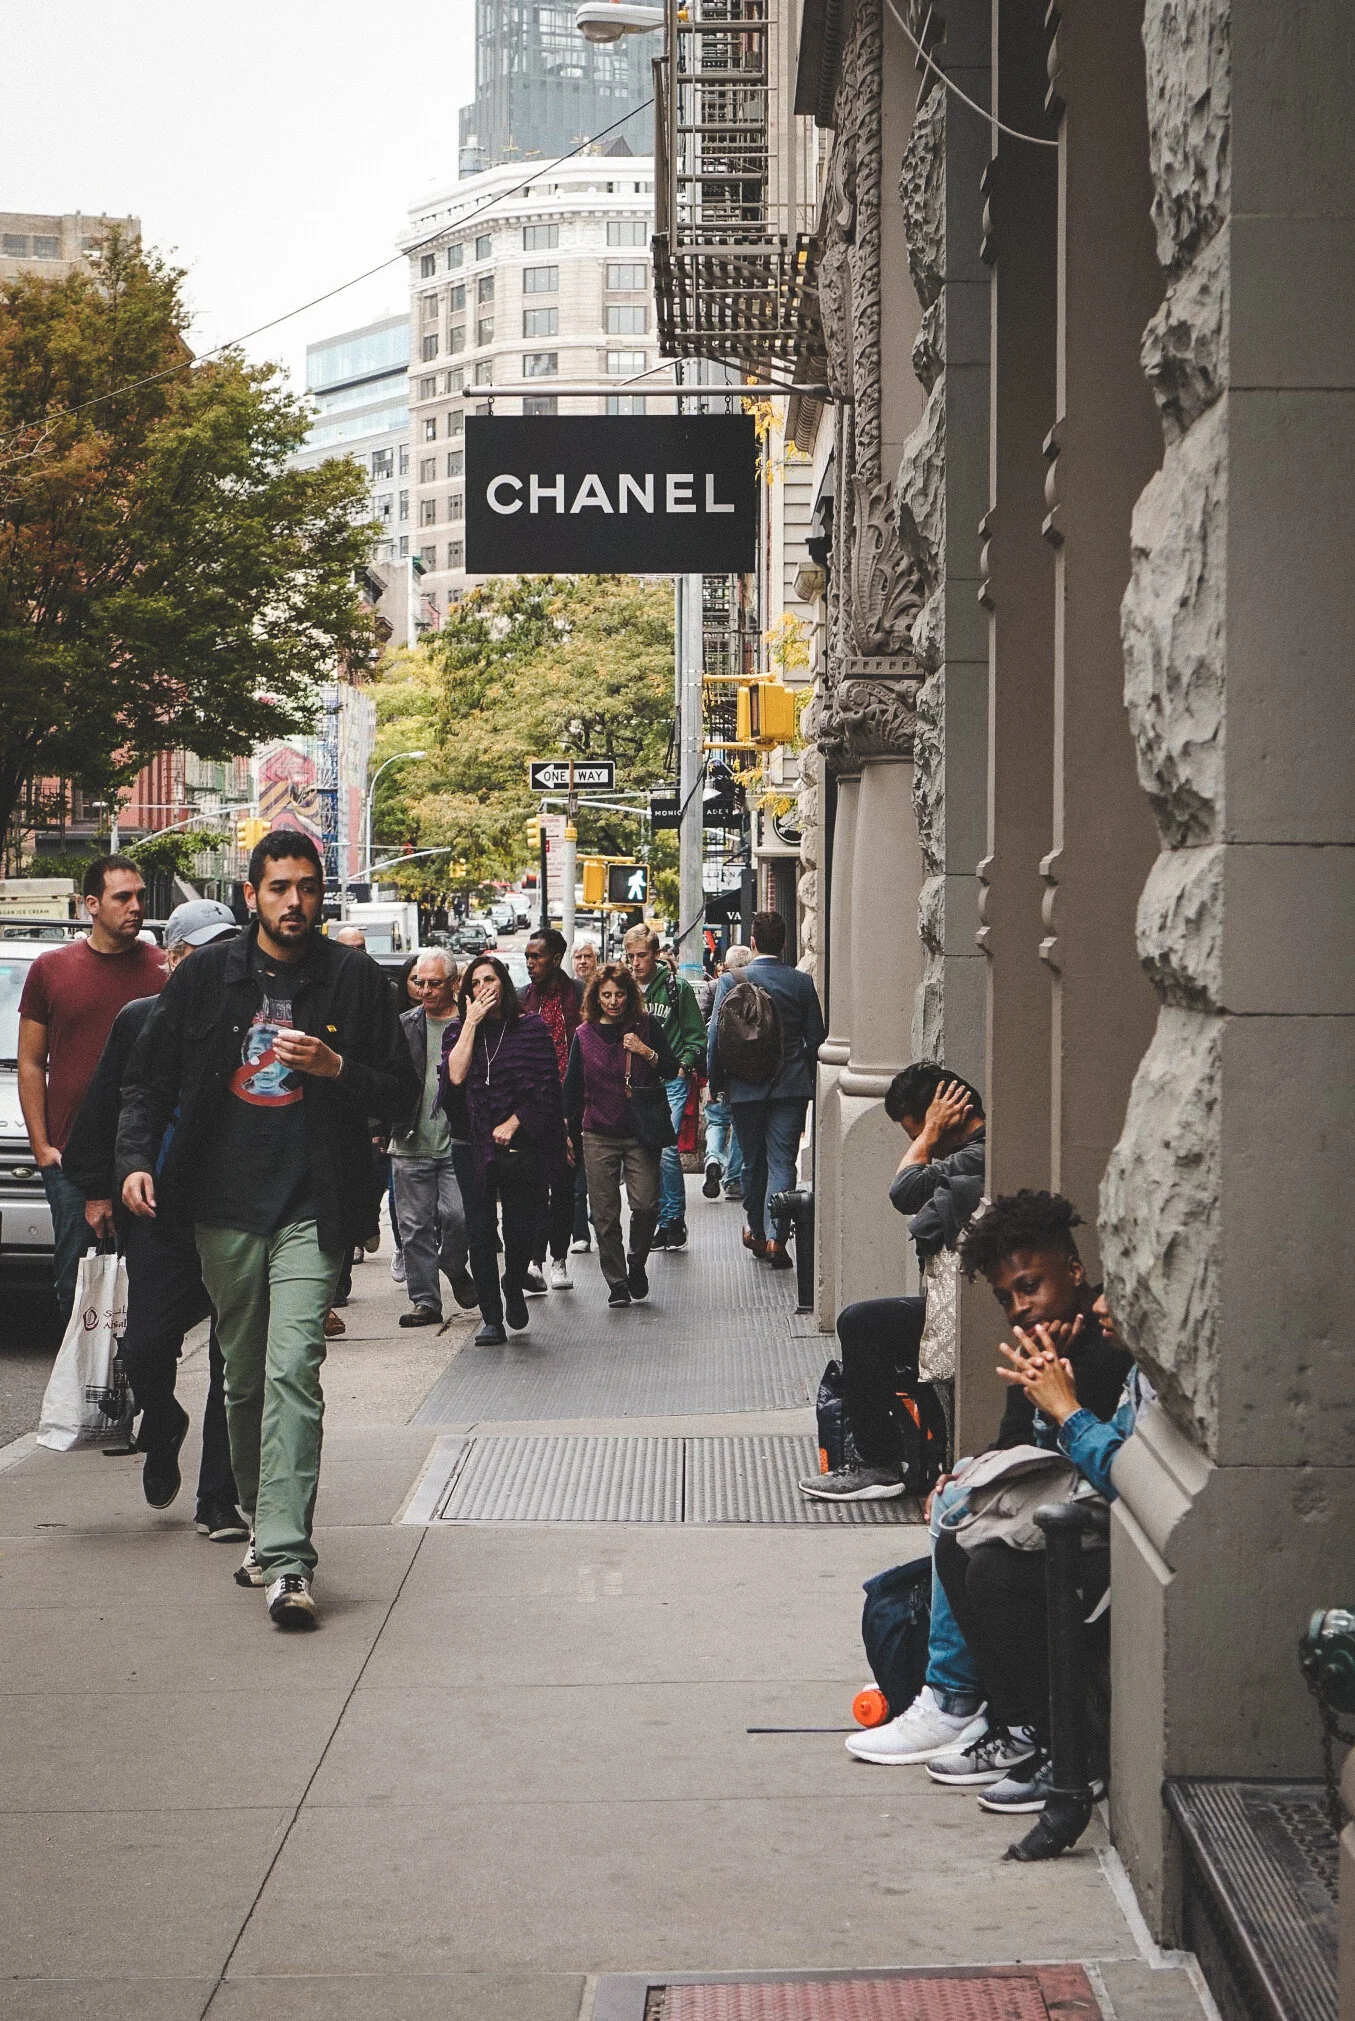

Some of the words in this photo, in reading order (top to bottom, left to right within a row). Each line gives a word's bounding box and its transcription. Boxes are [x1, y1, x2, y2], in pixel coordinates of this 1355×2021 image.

[487, 473, 735, 515] CHANEL
[543, 771, 567, 782] ONE
[578, 770, 603, 781] WAY
